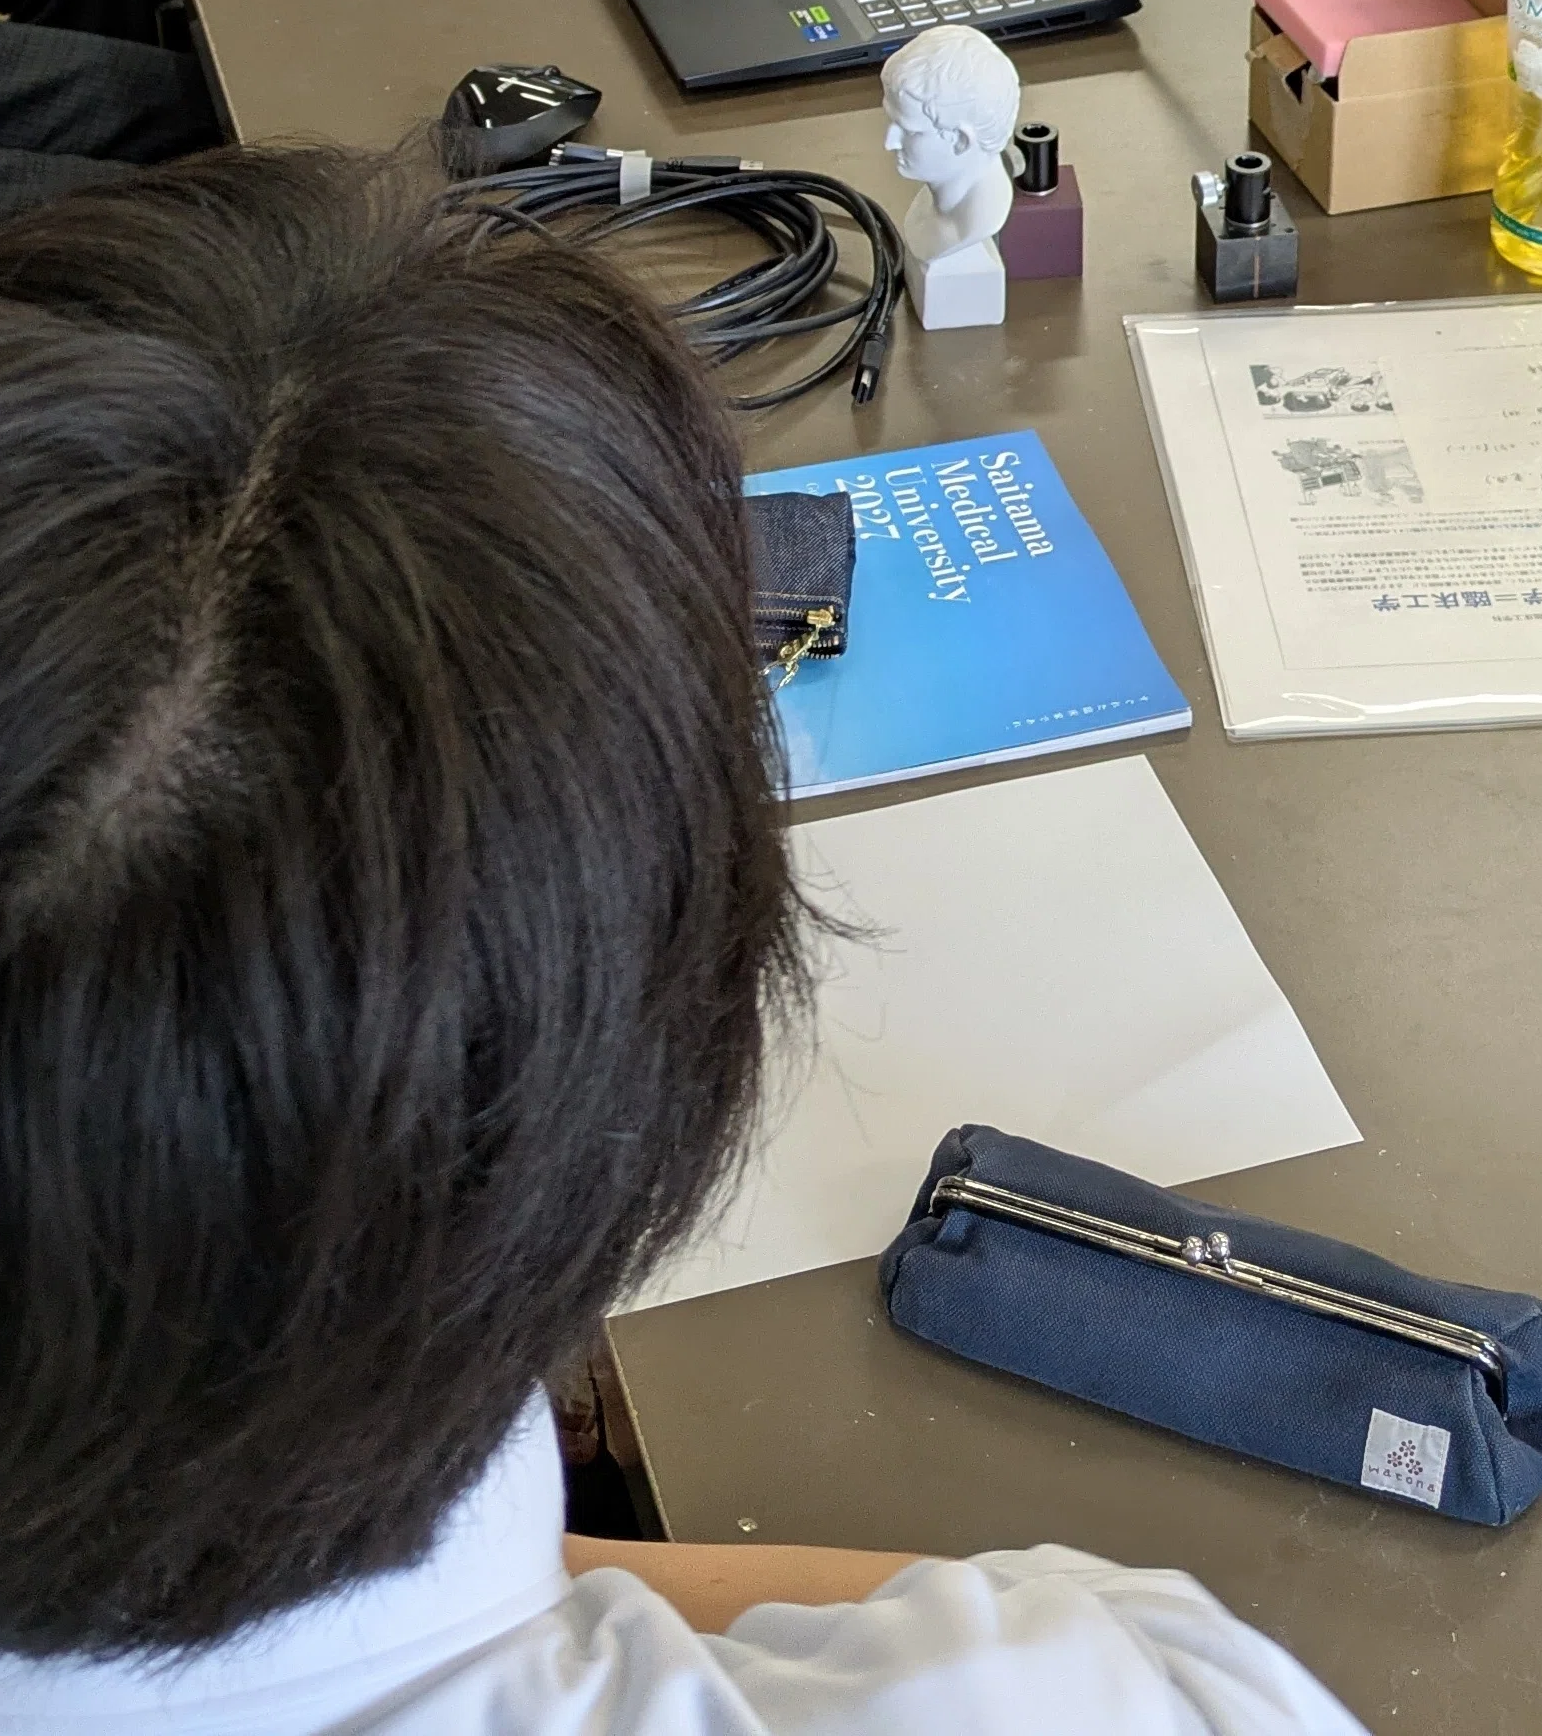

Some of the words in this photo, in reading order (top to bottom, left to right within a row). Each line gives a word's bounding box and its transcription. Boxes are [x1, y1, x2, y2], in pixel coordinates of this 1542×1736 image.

[835, 474, 900, 541] 2027
[885, 465, 971, 604] University
[934, 456, 1018, 566] Medical
[978, 451, 1054, 558] Saitama
